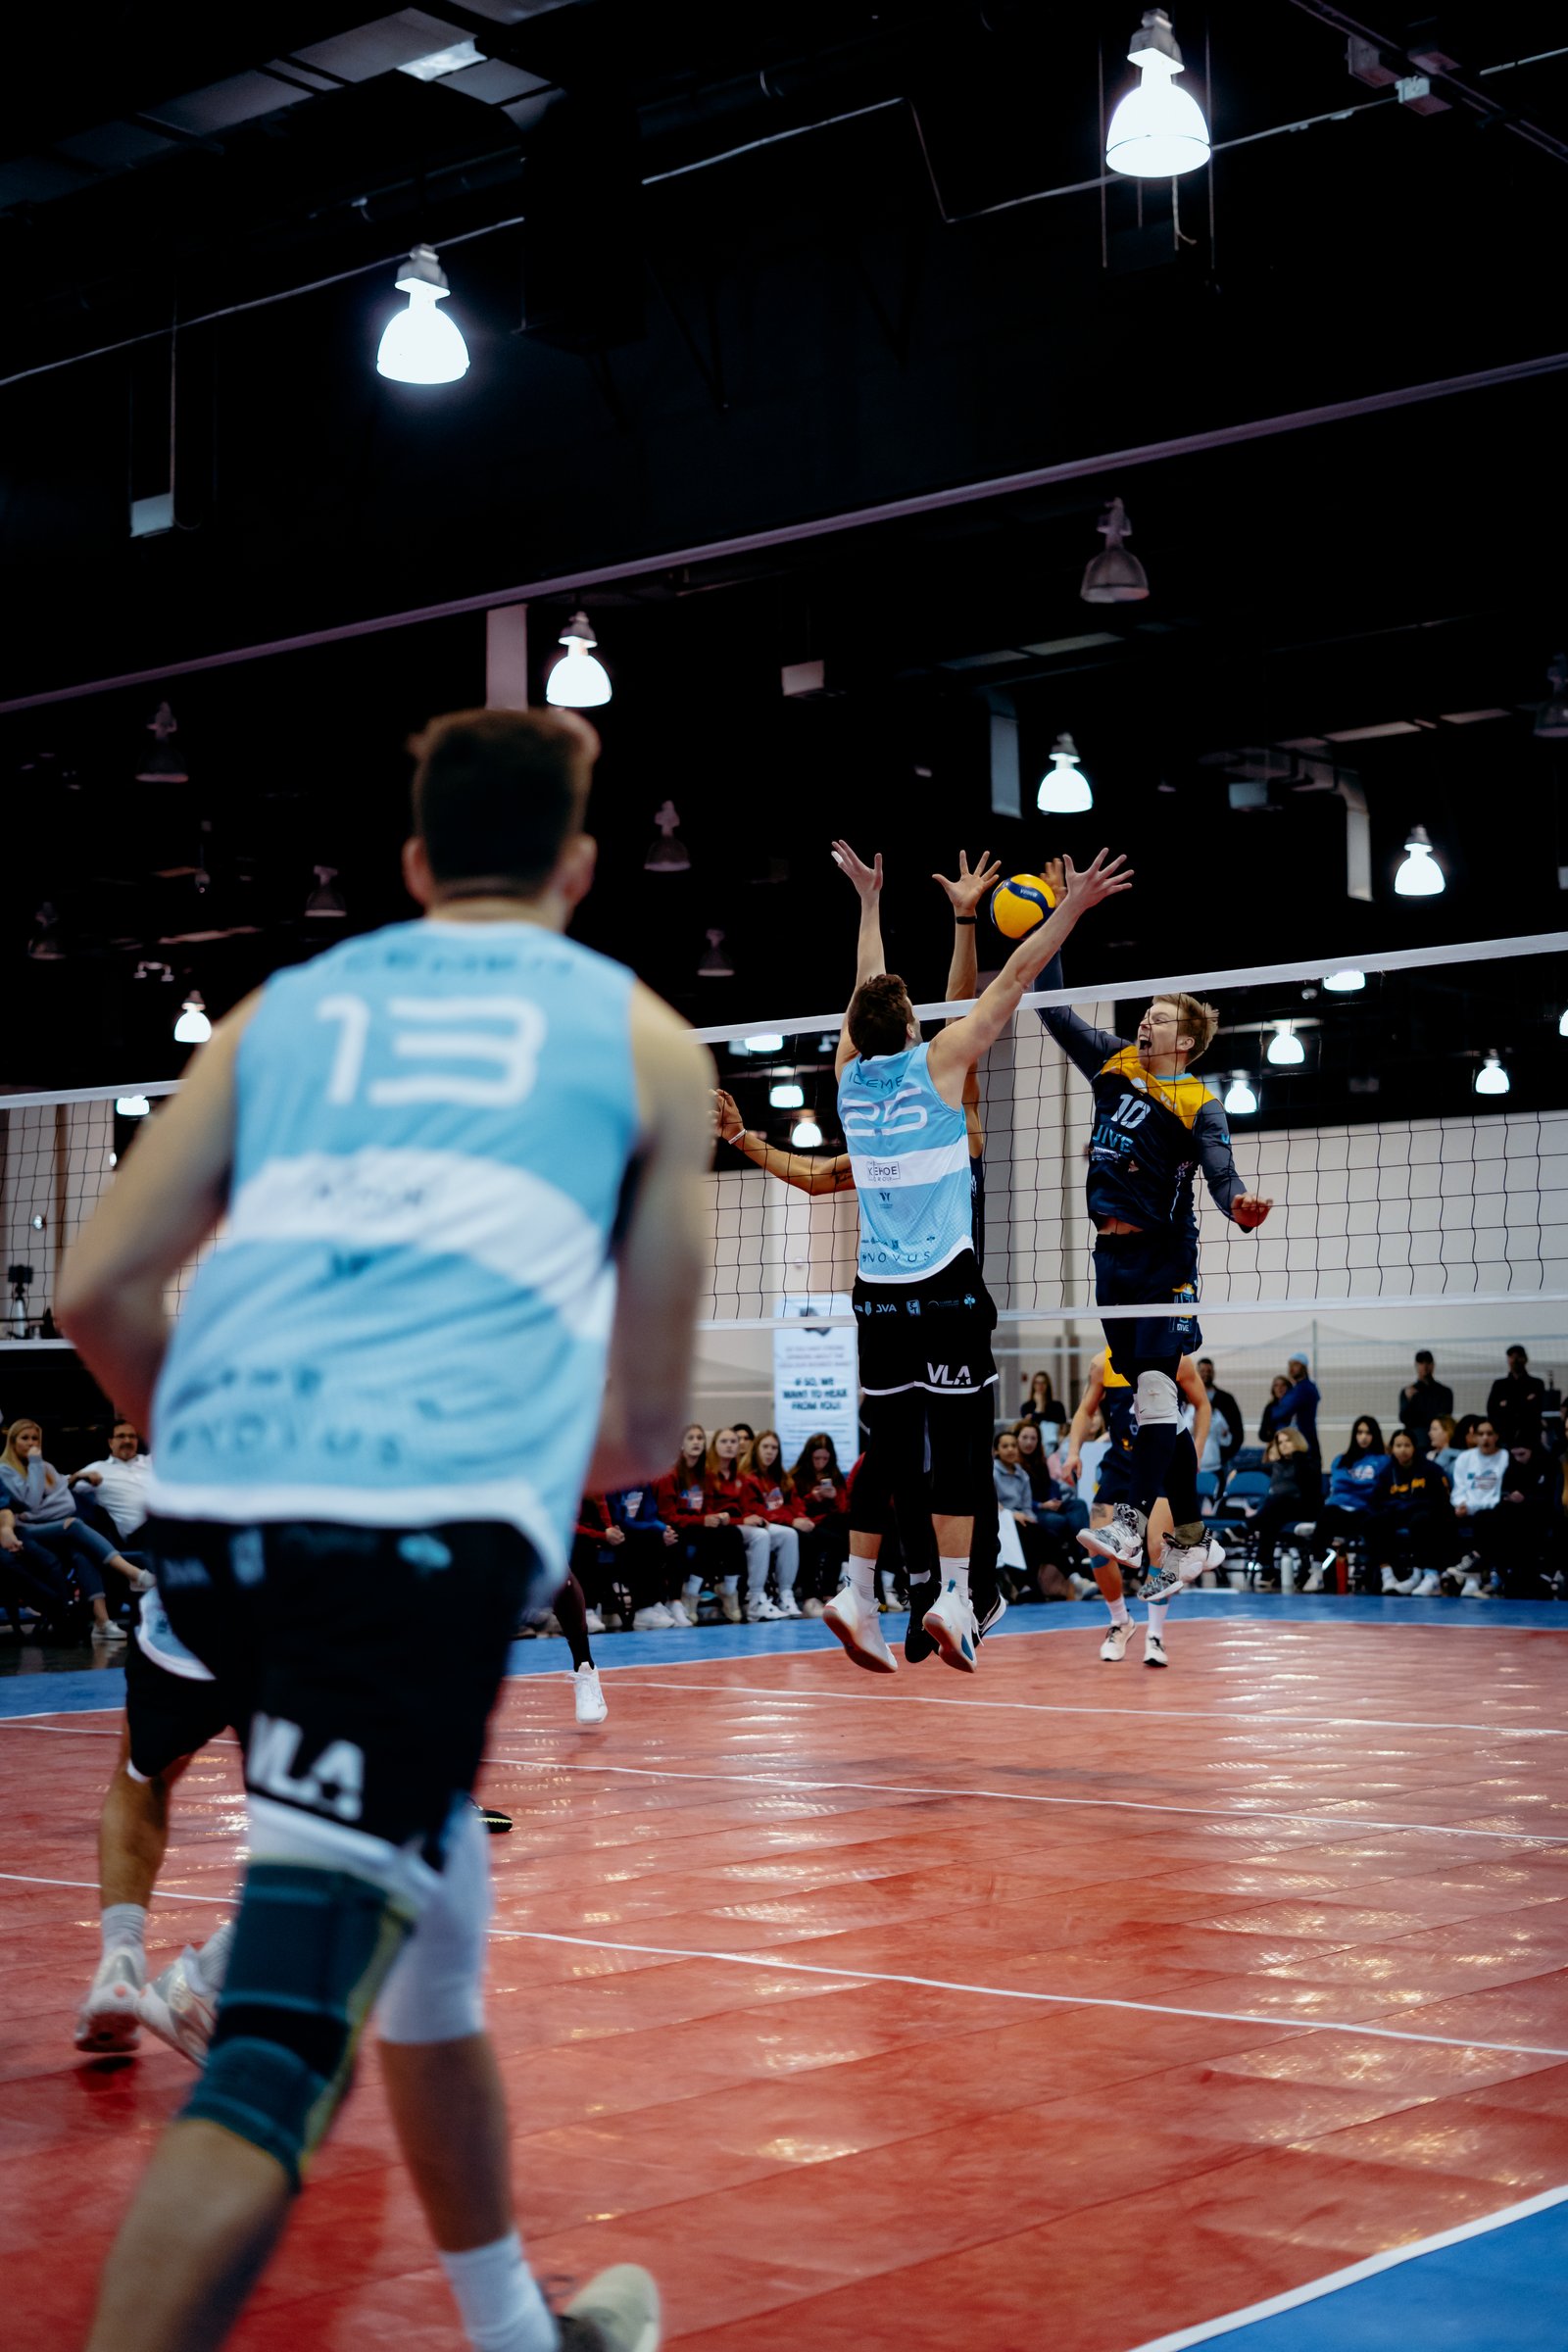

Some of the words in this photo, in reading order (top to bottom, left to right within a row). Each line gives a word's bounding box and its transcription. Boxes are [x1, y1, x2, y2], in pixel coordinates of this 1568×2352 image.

[316, 993, 549, 1107] 13
[841, 1087, 928, 1137] 25
[1110, 1093, 1152, 1129] 10
[867, 1165, 898, 1176] KEHOE
[866, 1250, 932, 1263] NOVUS
[875, 1303, 897, 1313] JVA
[927, 1361, 971, 1385] VLA
[248, 1712, 364, 1822] VLA
